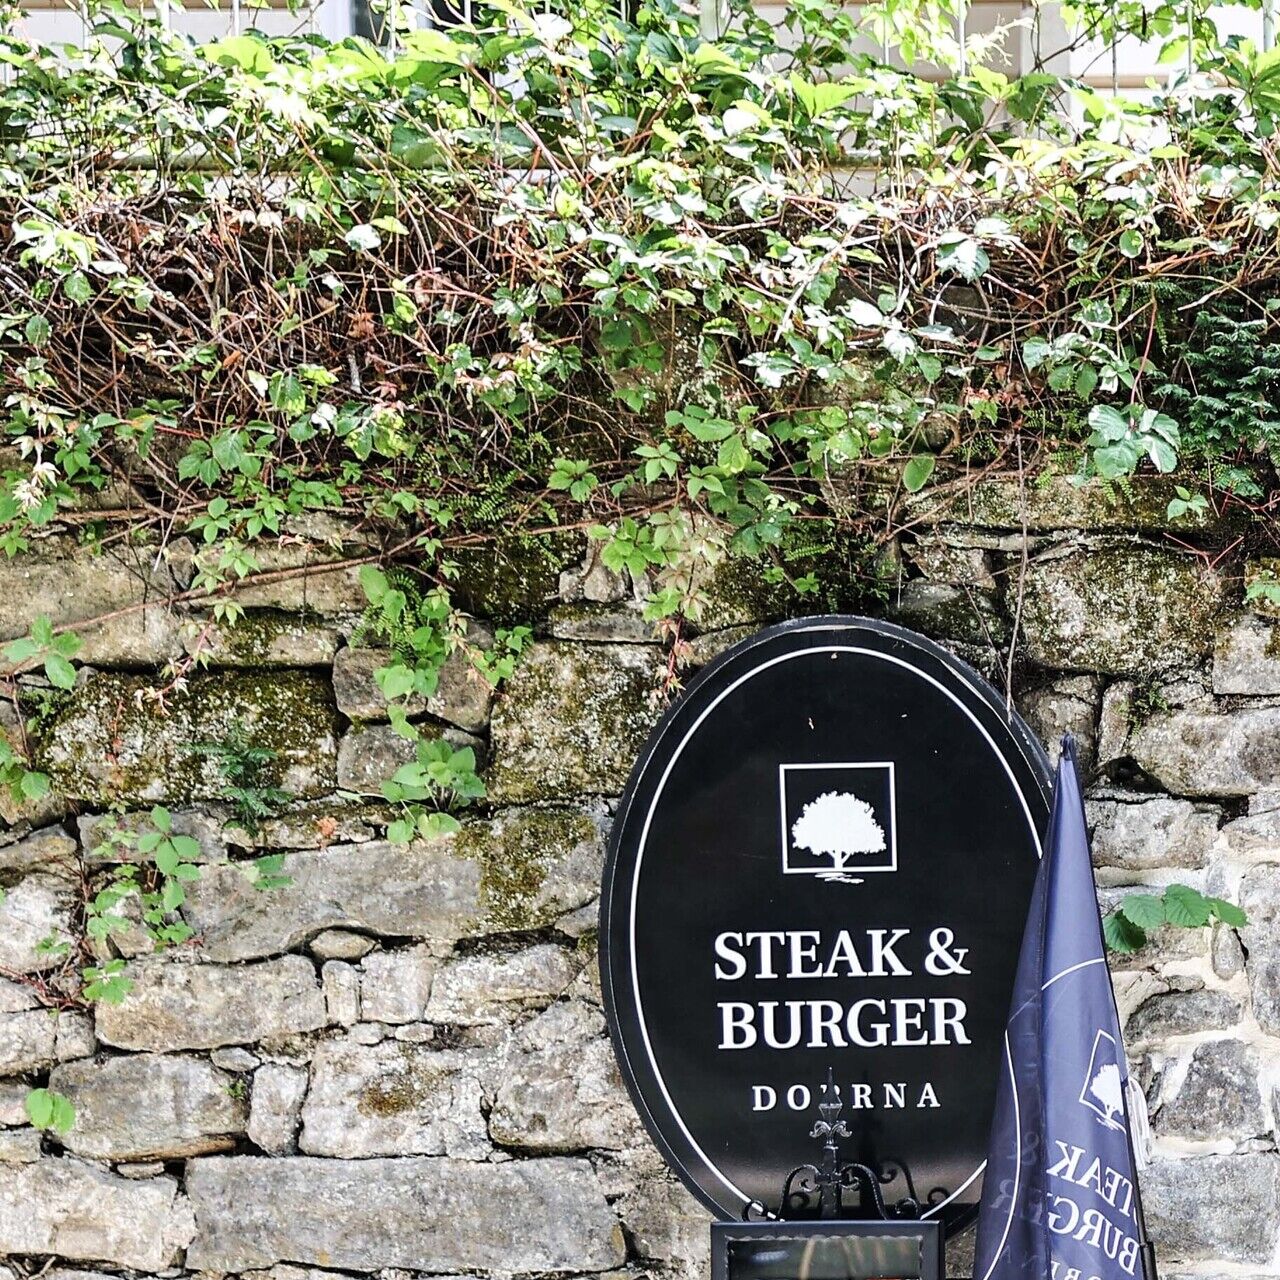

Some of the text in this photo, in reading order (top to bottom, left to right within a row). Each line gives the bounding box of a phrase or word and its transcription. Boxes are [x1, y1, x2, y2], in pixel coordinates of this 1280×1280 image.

[714, 928, 971, 980] STEAK &
[718, 998, 972, 1049] BURGER
[752, 1082, 941, 1111] DORNA
